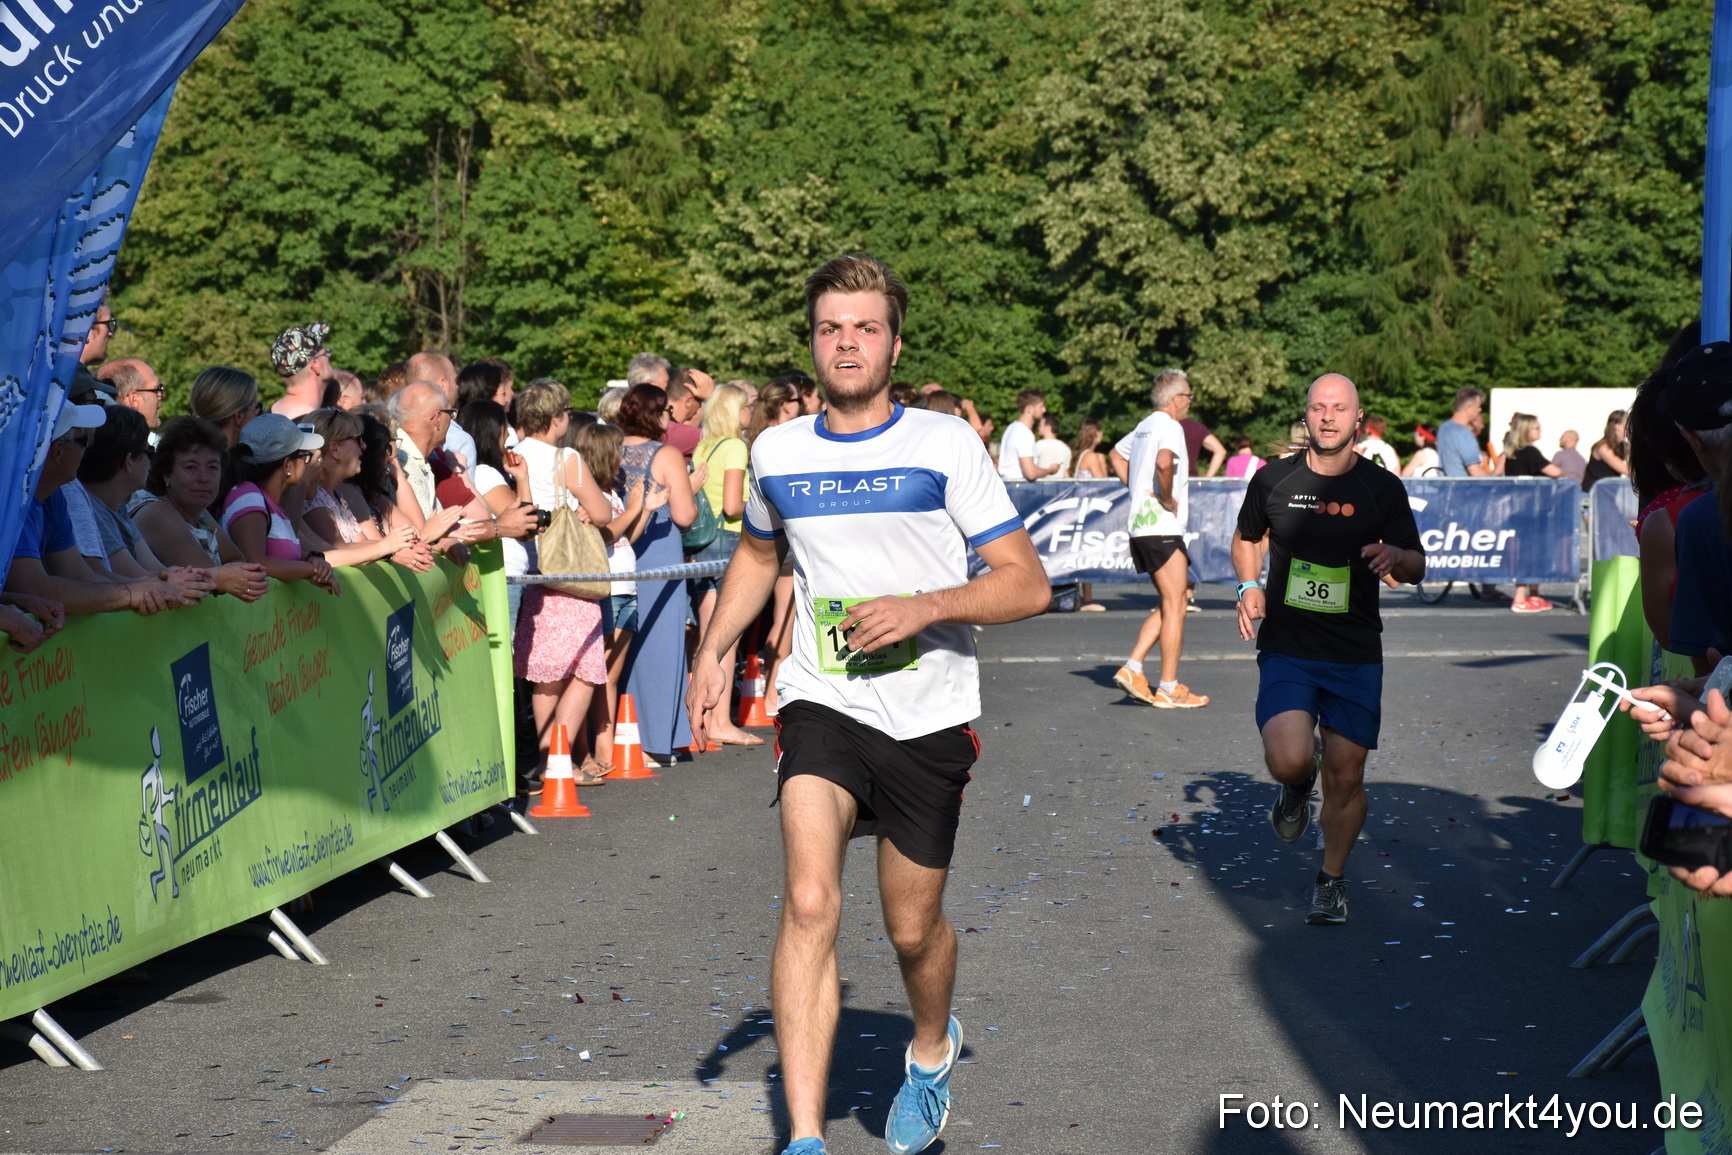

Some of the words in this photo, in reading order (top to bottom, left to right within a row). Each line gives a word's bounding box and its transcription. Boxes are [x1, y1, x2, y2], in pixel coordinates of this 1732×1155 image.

[0, 45, 82, 138] Druck
[819, 476, 906, 495] PLAST
[819, 500, 871, 508] GROUP
[1305, 580, 1330, 600] 36
[863, 652, 887, 660] Niklas
[183, 687, 209, 717] Fischer
[380, 670, 441, 778] firmenlauf
[174, 726, 262, 853] firmenlauf
[181, 835, 223, 887] neumarkt
